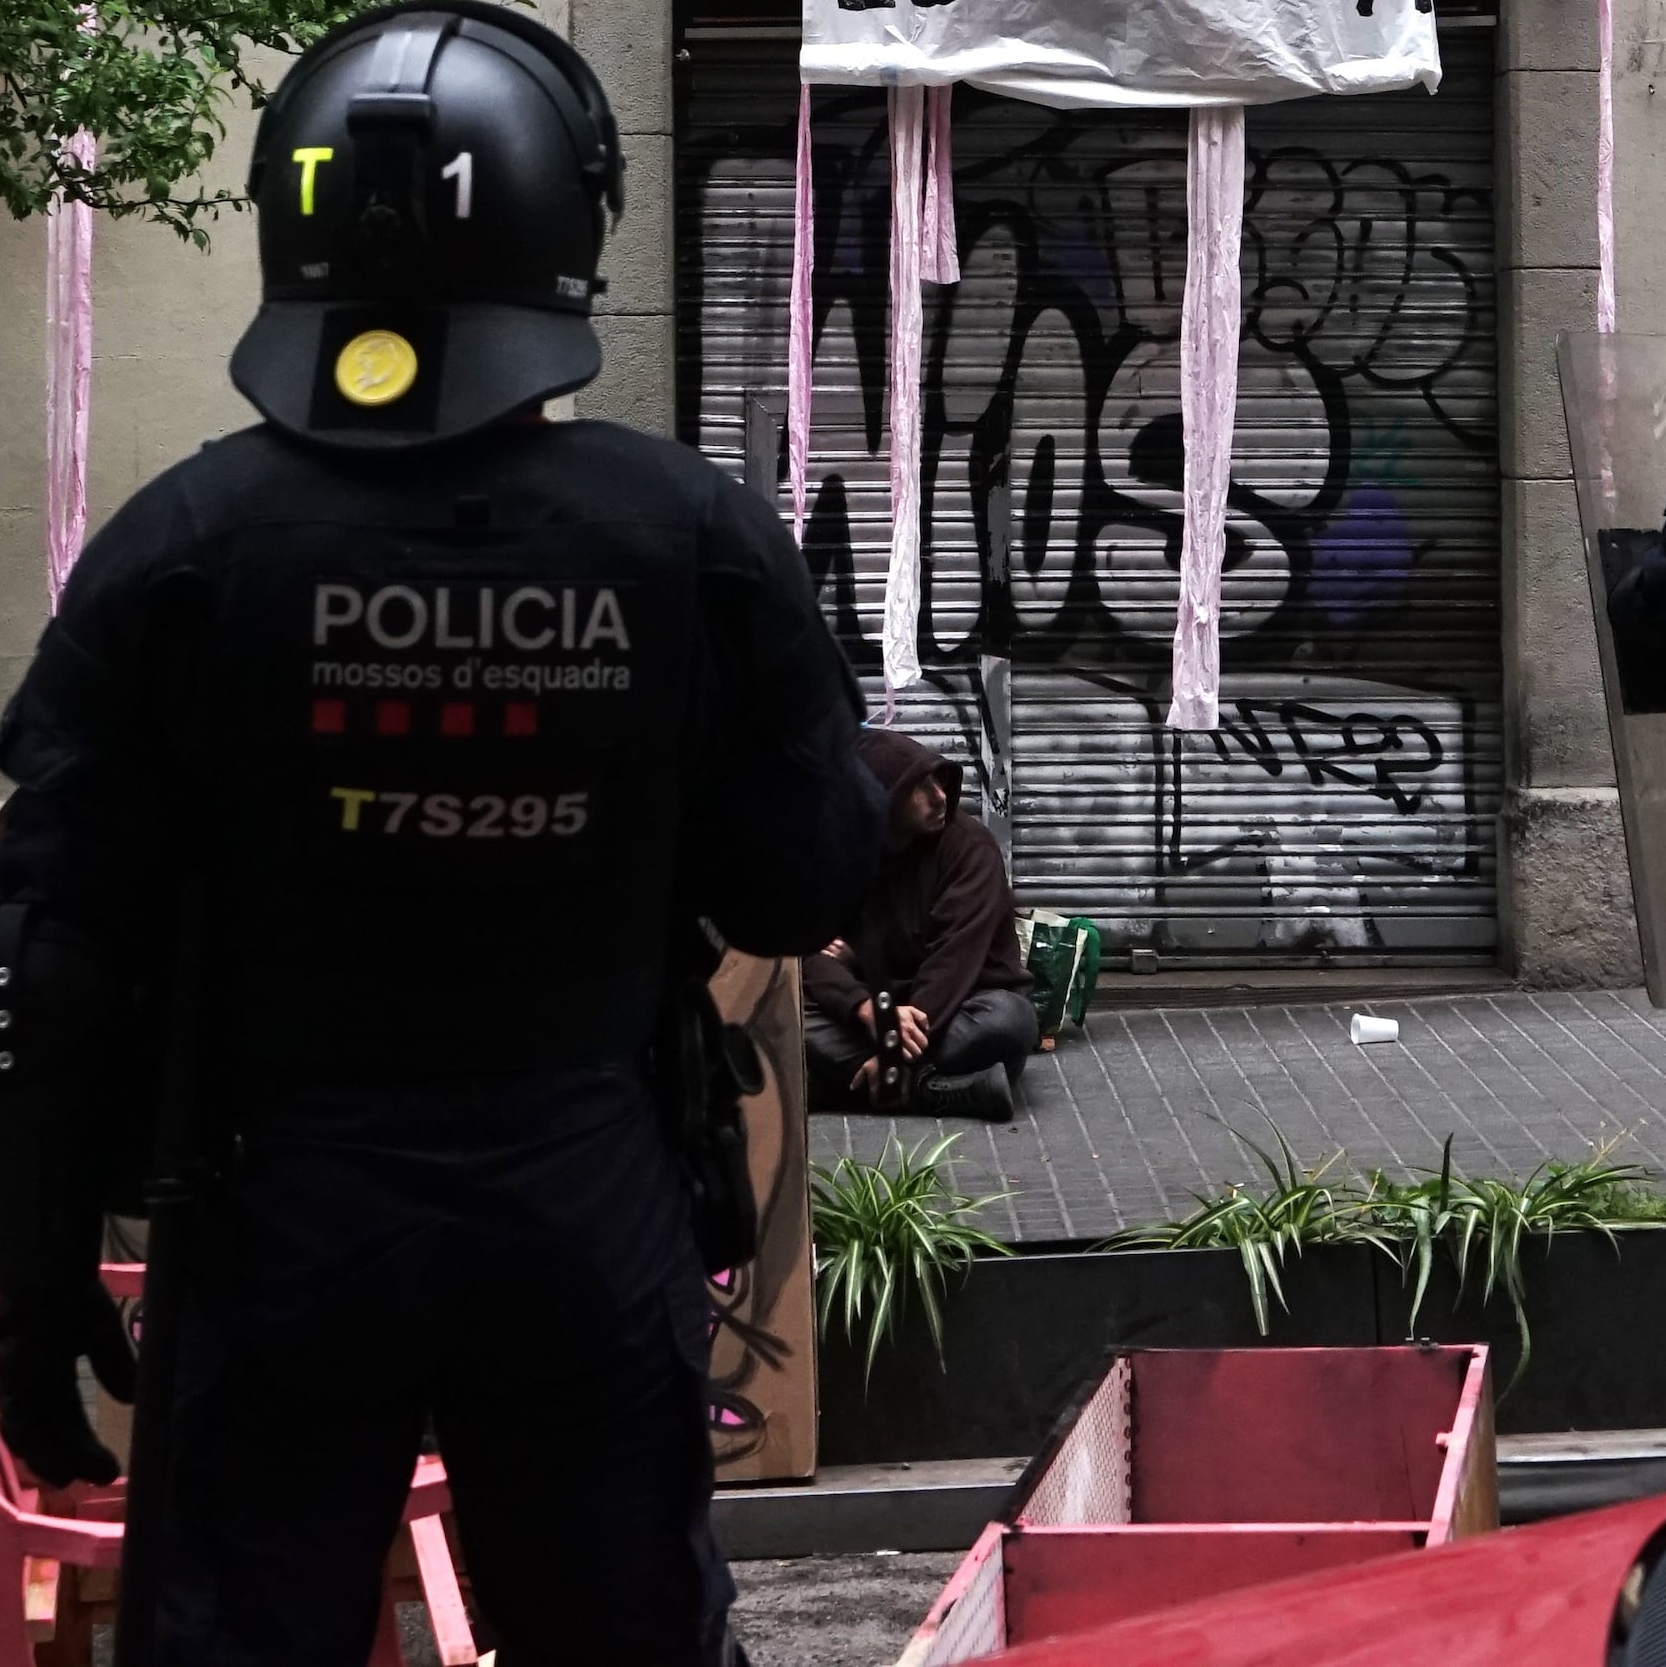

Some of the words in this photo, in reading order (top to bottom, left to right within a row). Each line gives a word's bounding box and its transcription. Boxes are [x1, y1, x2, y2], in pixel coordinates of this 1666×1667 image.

[291, 147, 333, 216] T
[441, 152, 473, 219] 1
[312, 583, 632, 651] POLICIA
[312, 659, 442, 688] mossos
[453, 657, 631, 695] d'esquadra
[330, 786, 589, 837] T7S295
